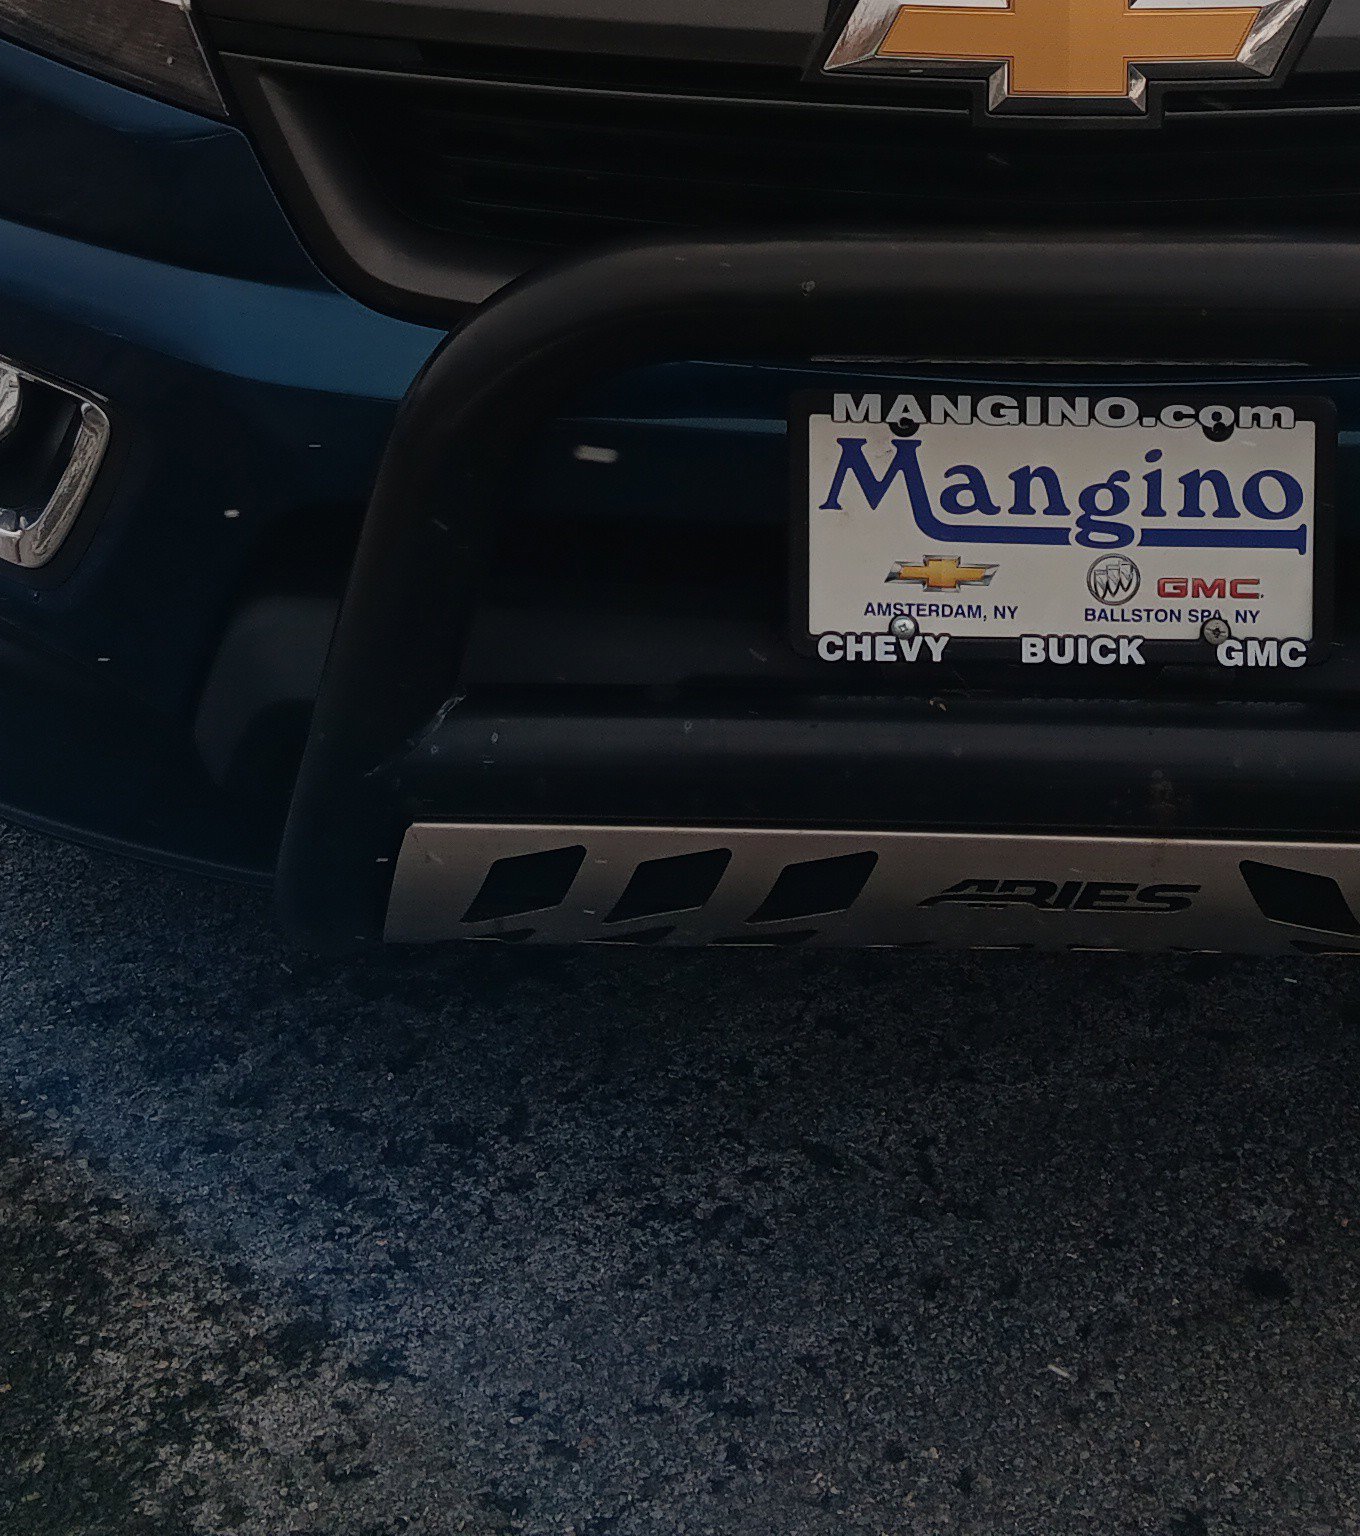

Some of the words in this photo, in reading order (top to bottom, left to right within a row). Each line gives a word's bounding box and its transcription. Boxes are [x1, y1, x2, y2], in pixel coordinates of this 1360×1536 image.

[832, 393, 1296, 429] MANGINO.com
[818, 437, 1308, 555] Mangino
[1157, 577, 1260, 599] GMC
[864, 602, 987, 622] AMSTERDAM,
[993, 605, 1019, 619] NY
[1084, 607, 1181, 623] BALLSTON
[1187, 608, 1228, 624] SPA
[1235, 610, 1260, 624] NY
[817, 634, 950, 662] CHEVY
[1021, 637, 1146, 665] BUICK
[1216, 639, 1307, 668] GMC
[916, 878, 1202, 913] ARIES
